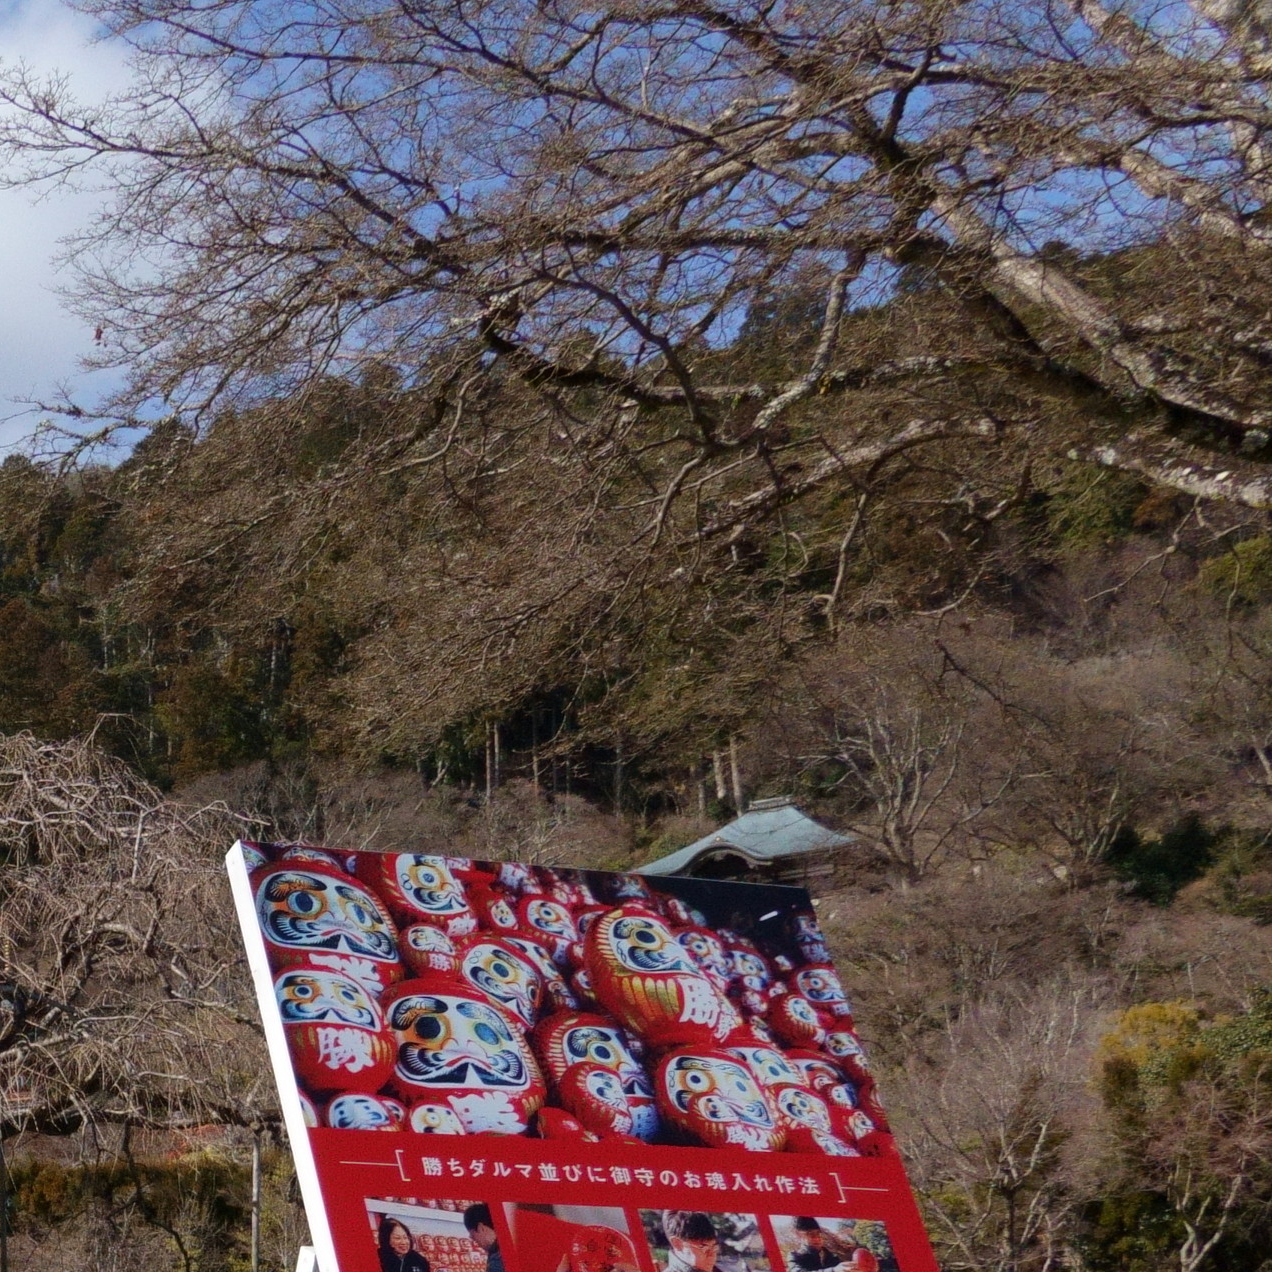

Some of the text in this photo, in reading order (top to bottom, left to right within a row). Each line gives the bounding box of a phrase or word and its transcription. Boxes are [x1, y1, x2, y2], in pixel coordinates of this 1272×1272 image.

[422, 1156, 821, 1196] 勝ちダルマ並びに御守のお魂入れ作法
